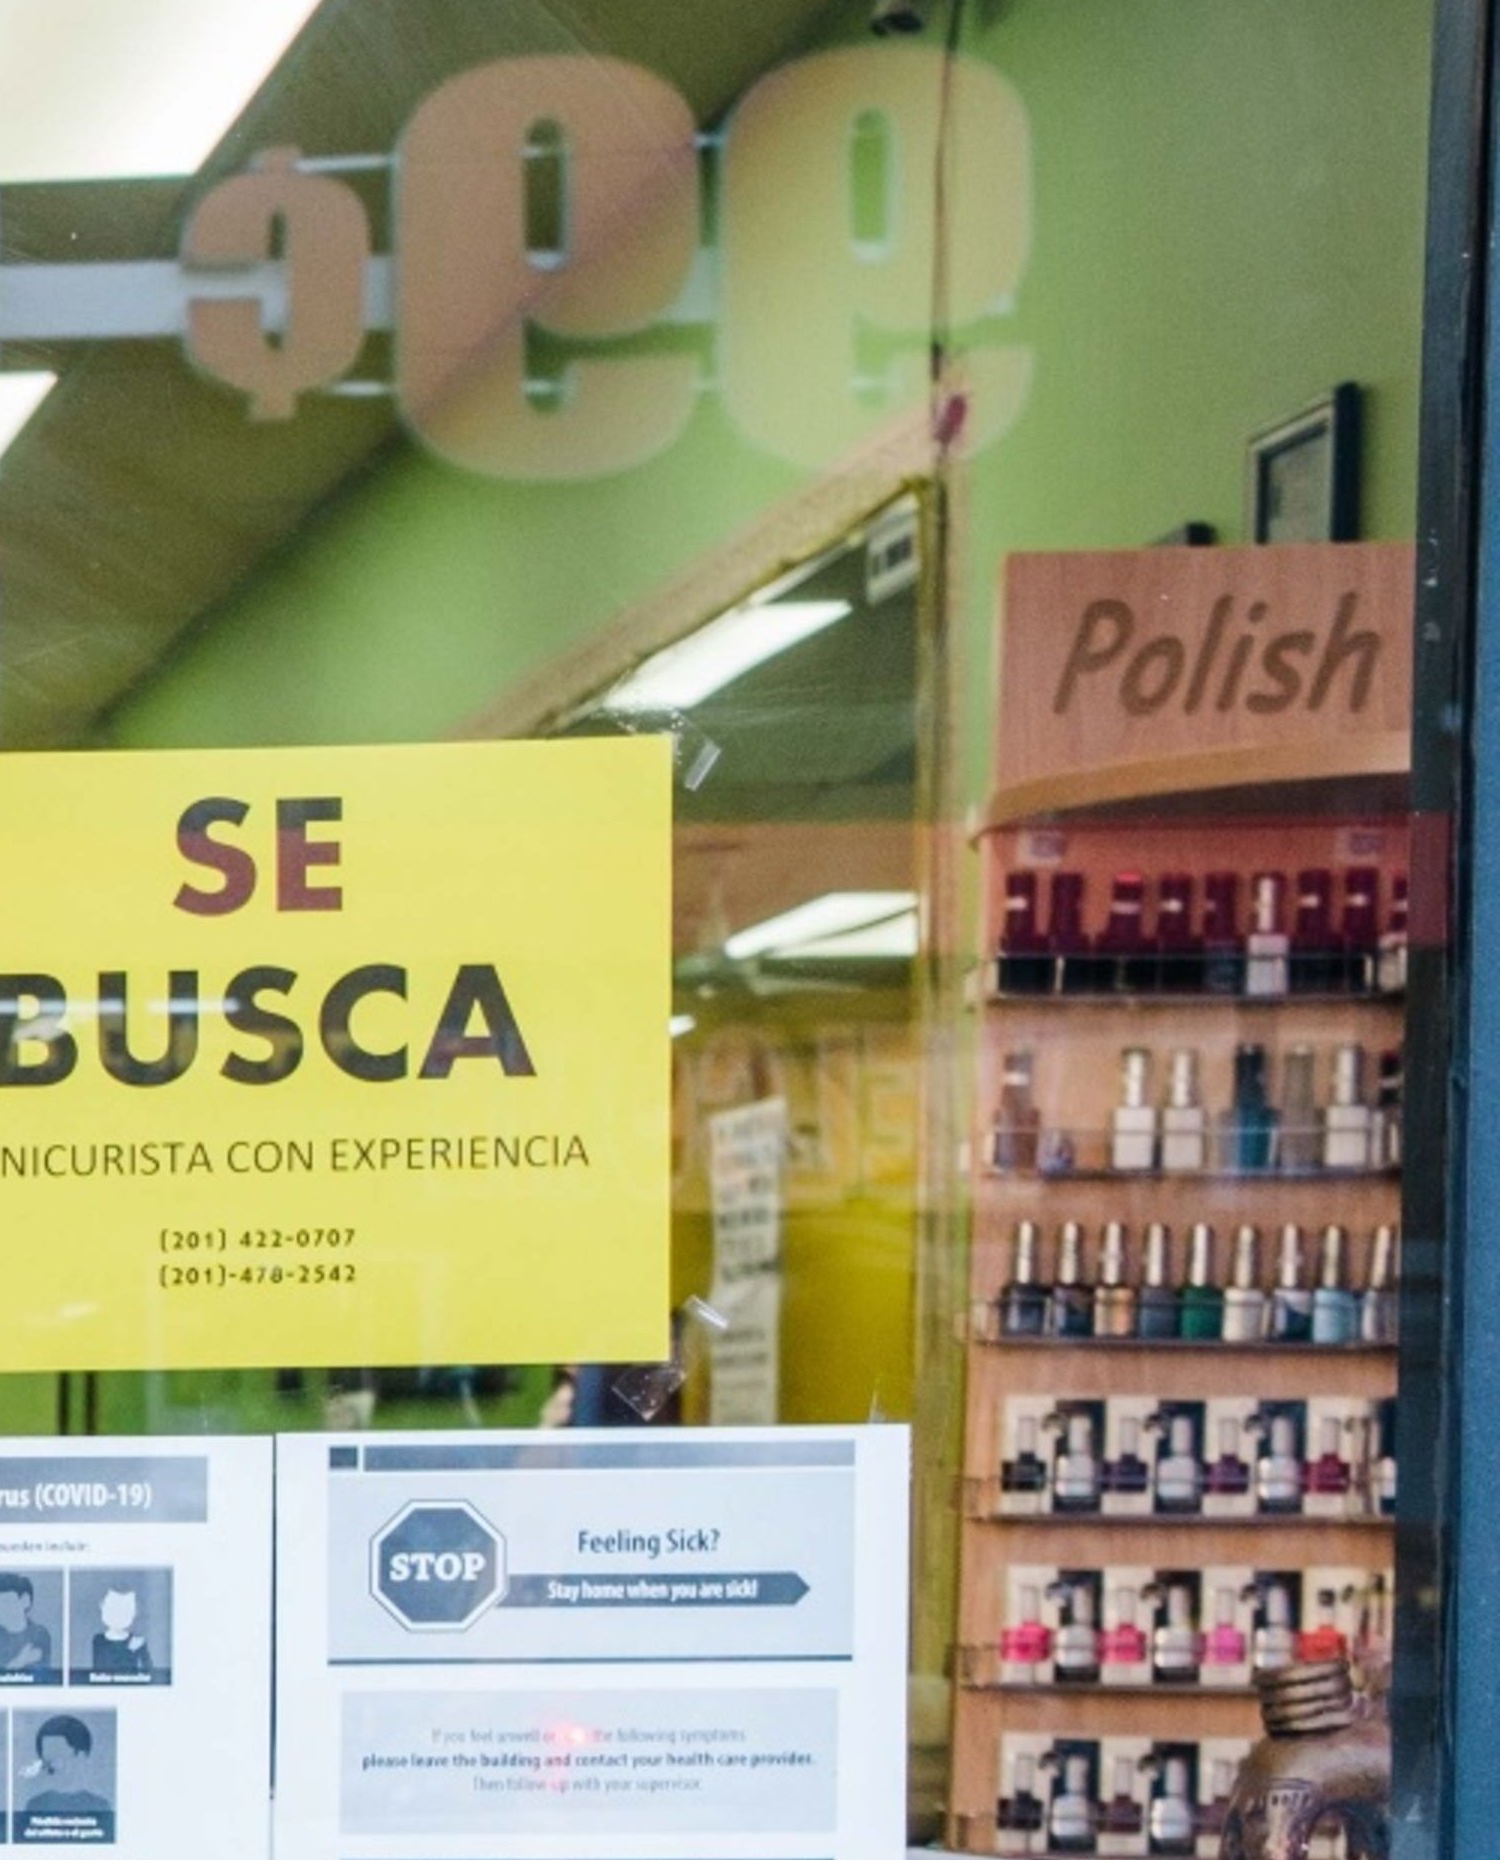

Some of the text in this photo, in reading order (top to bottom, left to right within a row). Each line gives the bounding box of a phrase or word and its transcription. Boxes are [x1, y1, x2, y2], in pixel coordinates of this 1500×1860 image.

[1054, 591, 1382, 717] Polish
[172, 795, 345, 918] SE
[227, 1139, 314, 1175] CON
[331, 1134, 590, 1173] EXPERIENCIA
[159, 1226, 358, 1252] (201) 422-0707
[159, 1263, 358, 1288] (201)-478-2542
[35, 1481, 152, 1510] (COVID-19)
[578, 1528, 721, 1558] Feeling Sick?
[389, 1552, 487, 1582] STOP
[547, 1580, 758, 1603] Stay home when you are sick!
